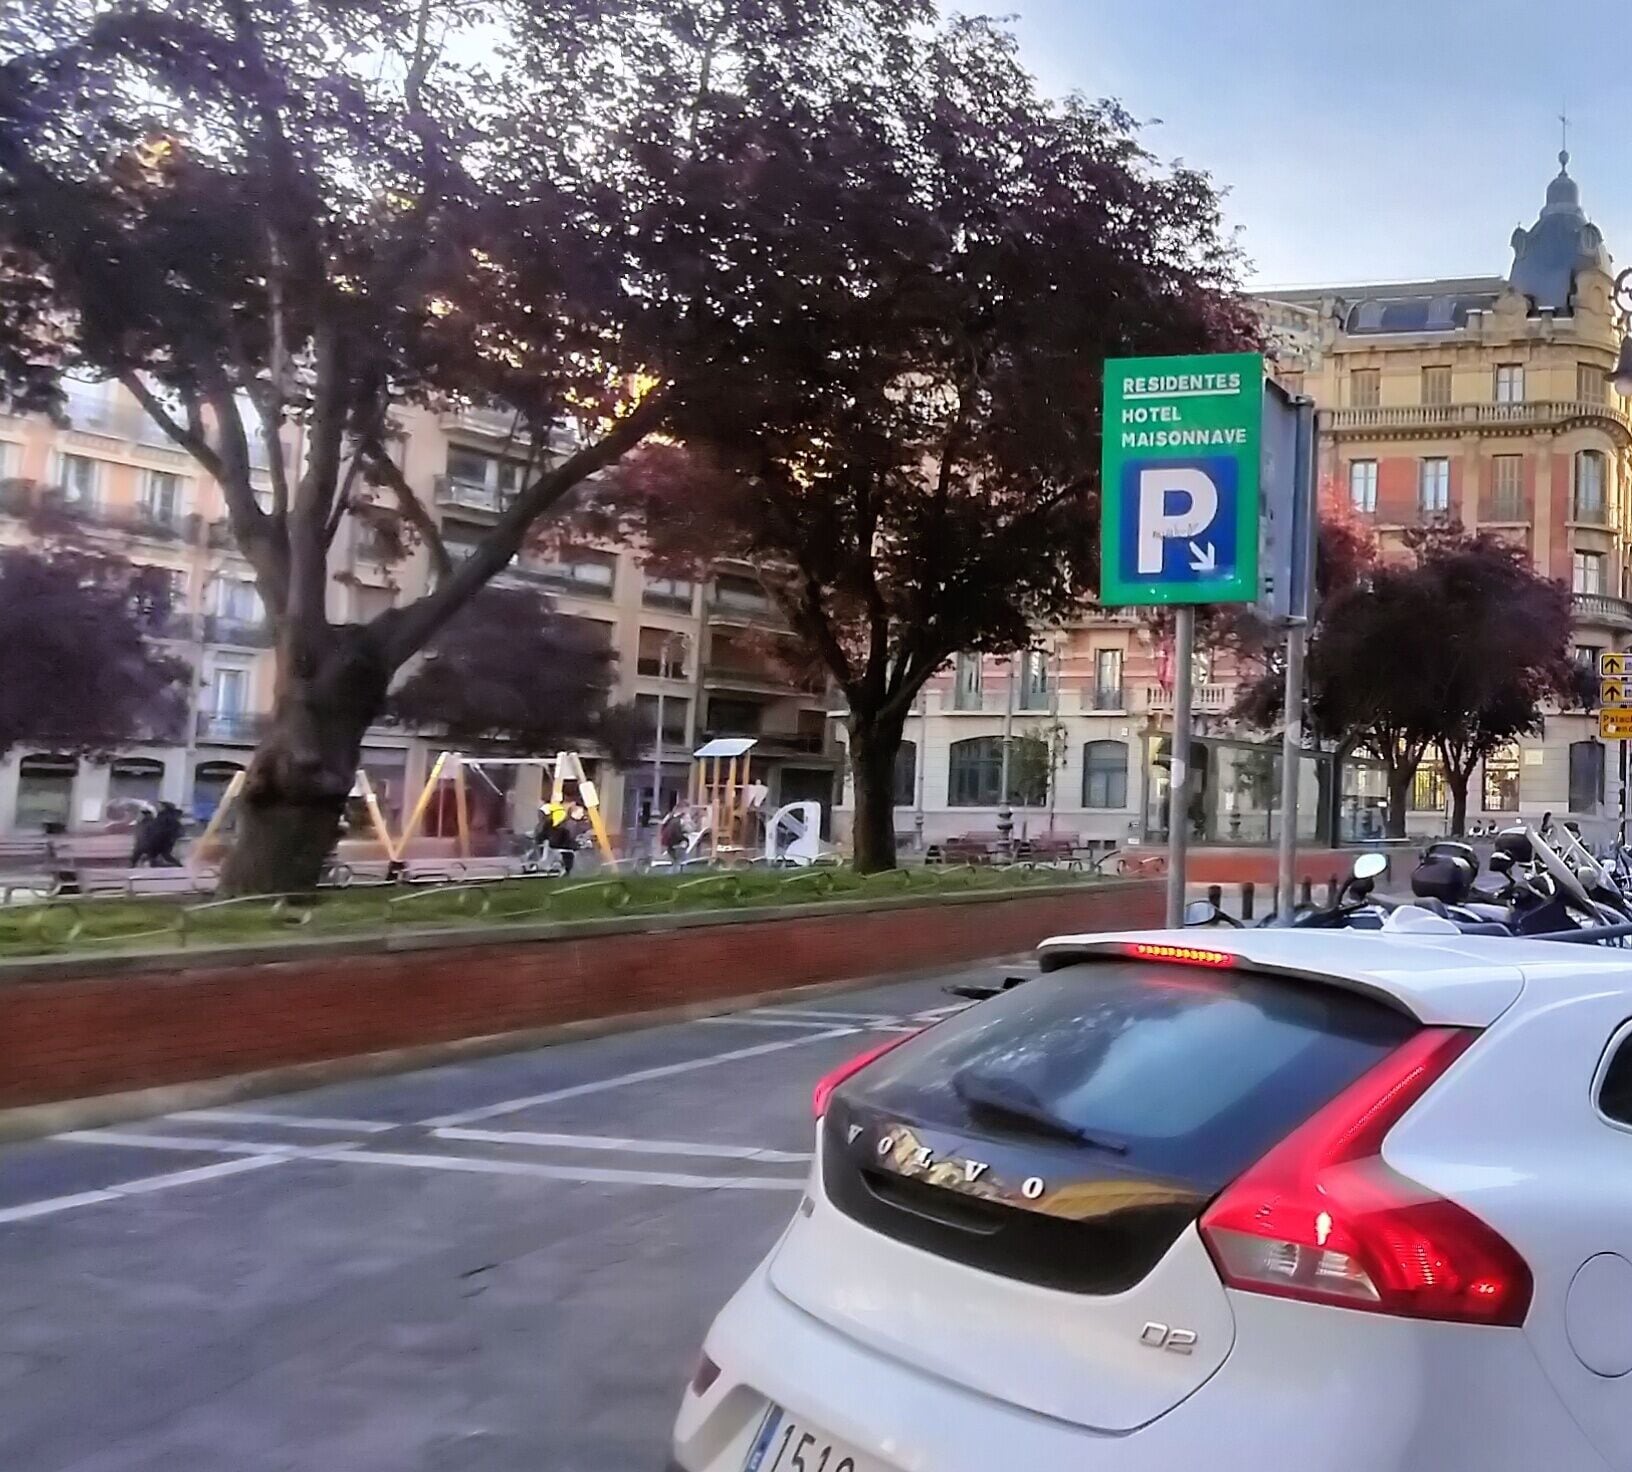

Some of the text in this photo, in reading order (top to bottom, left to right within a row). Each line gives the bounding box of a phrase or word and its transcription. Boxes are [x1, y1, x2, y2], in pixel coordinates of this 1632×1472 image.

[1123, 373, 1241, 393] RESIDENTES
[1122, 406, 1181, 423] HOTEL
[1122, 428, 1246, 448] MAISONNAVE
[1138, 468, 1218, 574] P
[847, 1124, 1045, 1199] VOLVO
[1141, 1320, 1198, 1355] D2
[770, 1424, 855, 1472] 151
